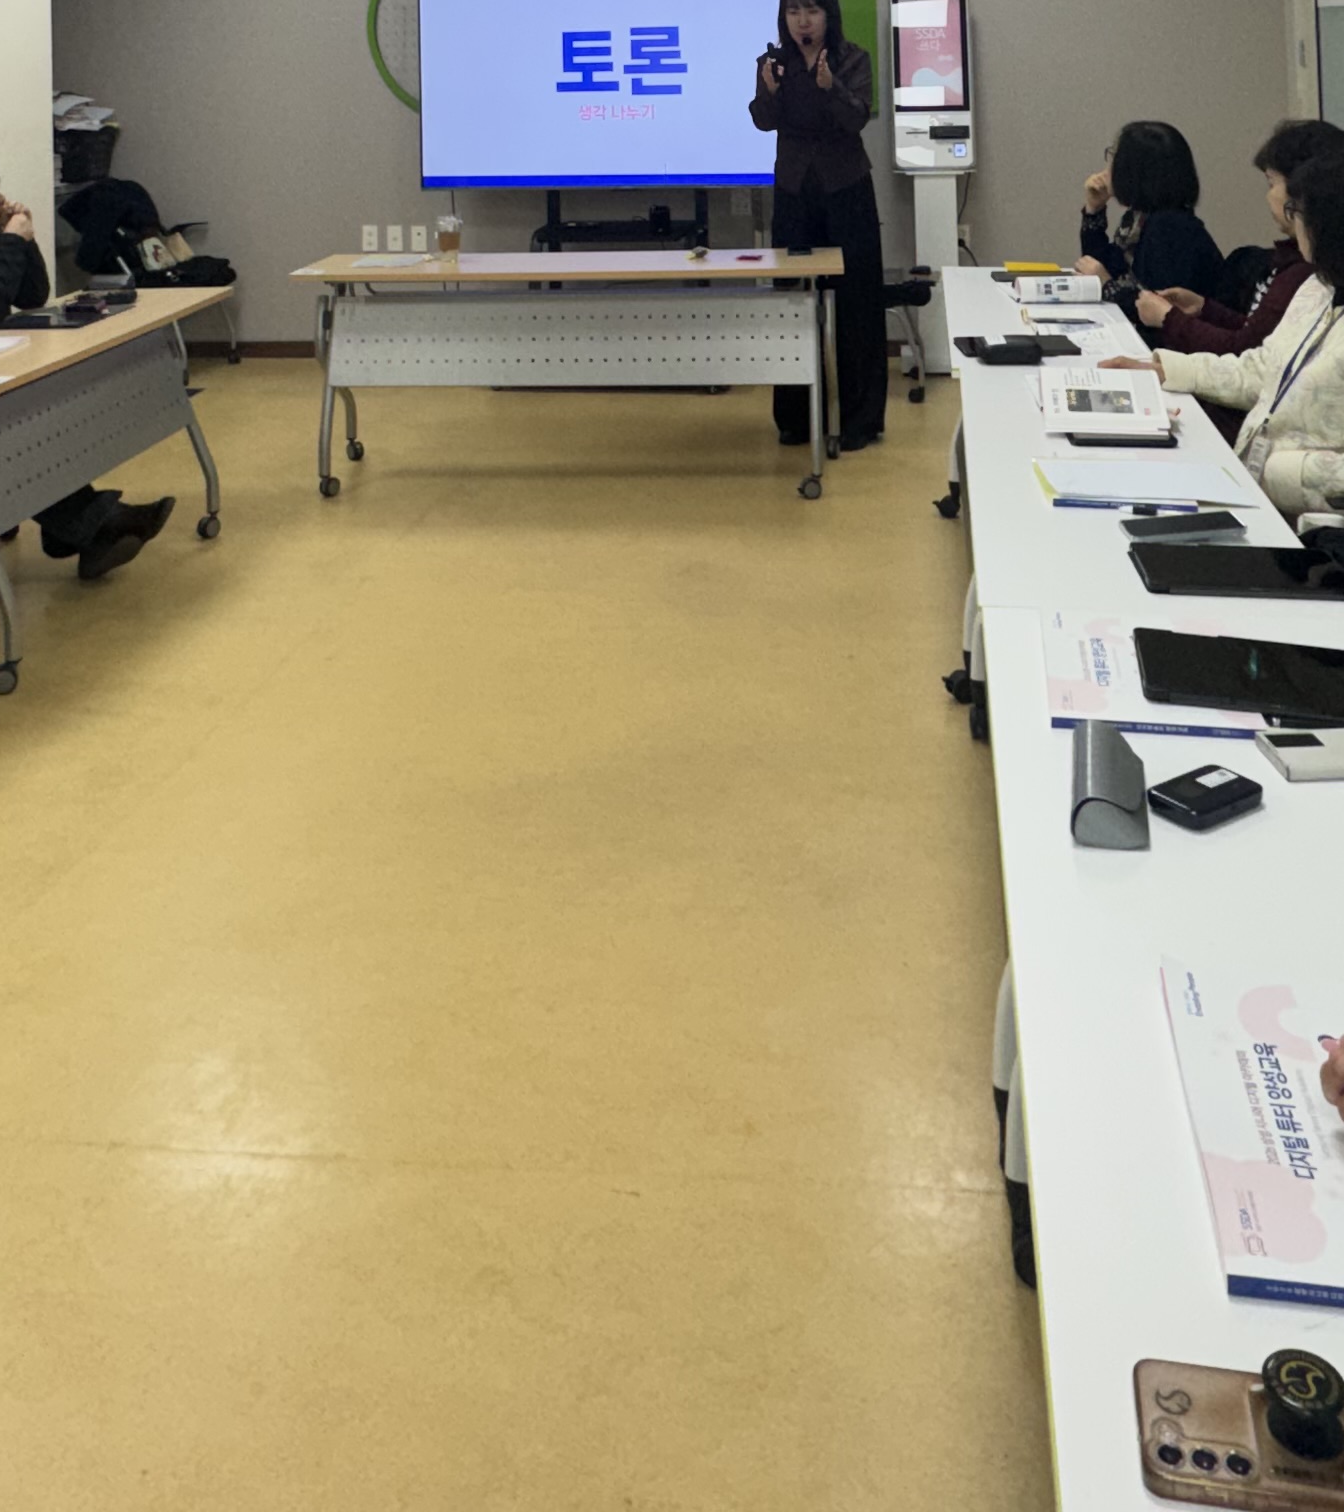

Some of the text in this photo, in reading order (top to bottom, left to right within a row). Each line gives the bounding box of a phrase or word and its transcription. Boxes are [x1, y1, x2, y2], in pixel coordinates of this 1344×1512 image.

[914, 27, 947, 41] SSDA
[556, 26, 688, 96] 토론
[578, 104, 655, 121] 생각 나누기
[1253, 1043, 1292, 1100] 양성교육
[1269, 1103, 1304, 1133] 튜터
[1280, 1135, 1317, 1179] 디지털
